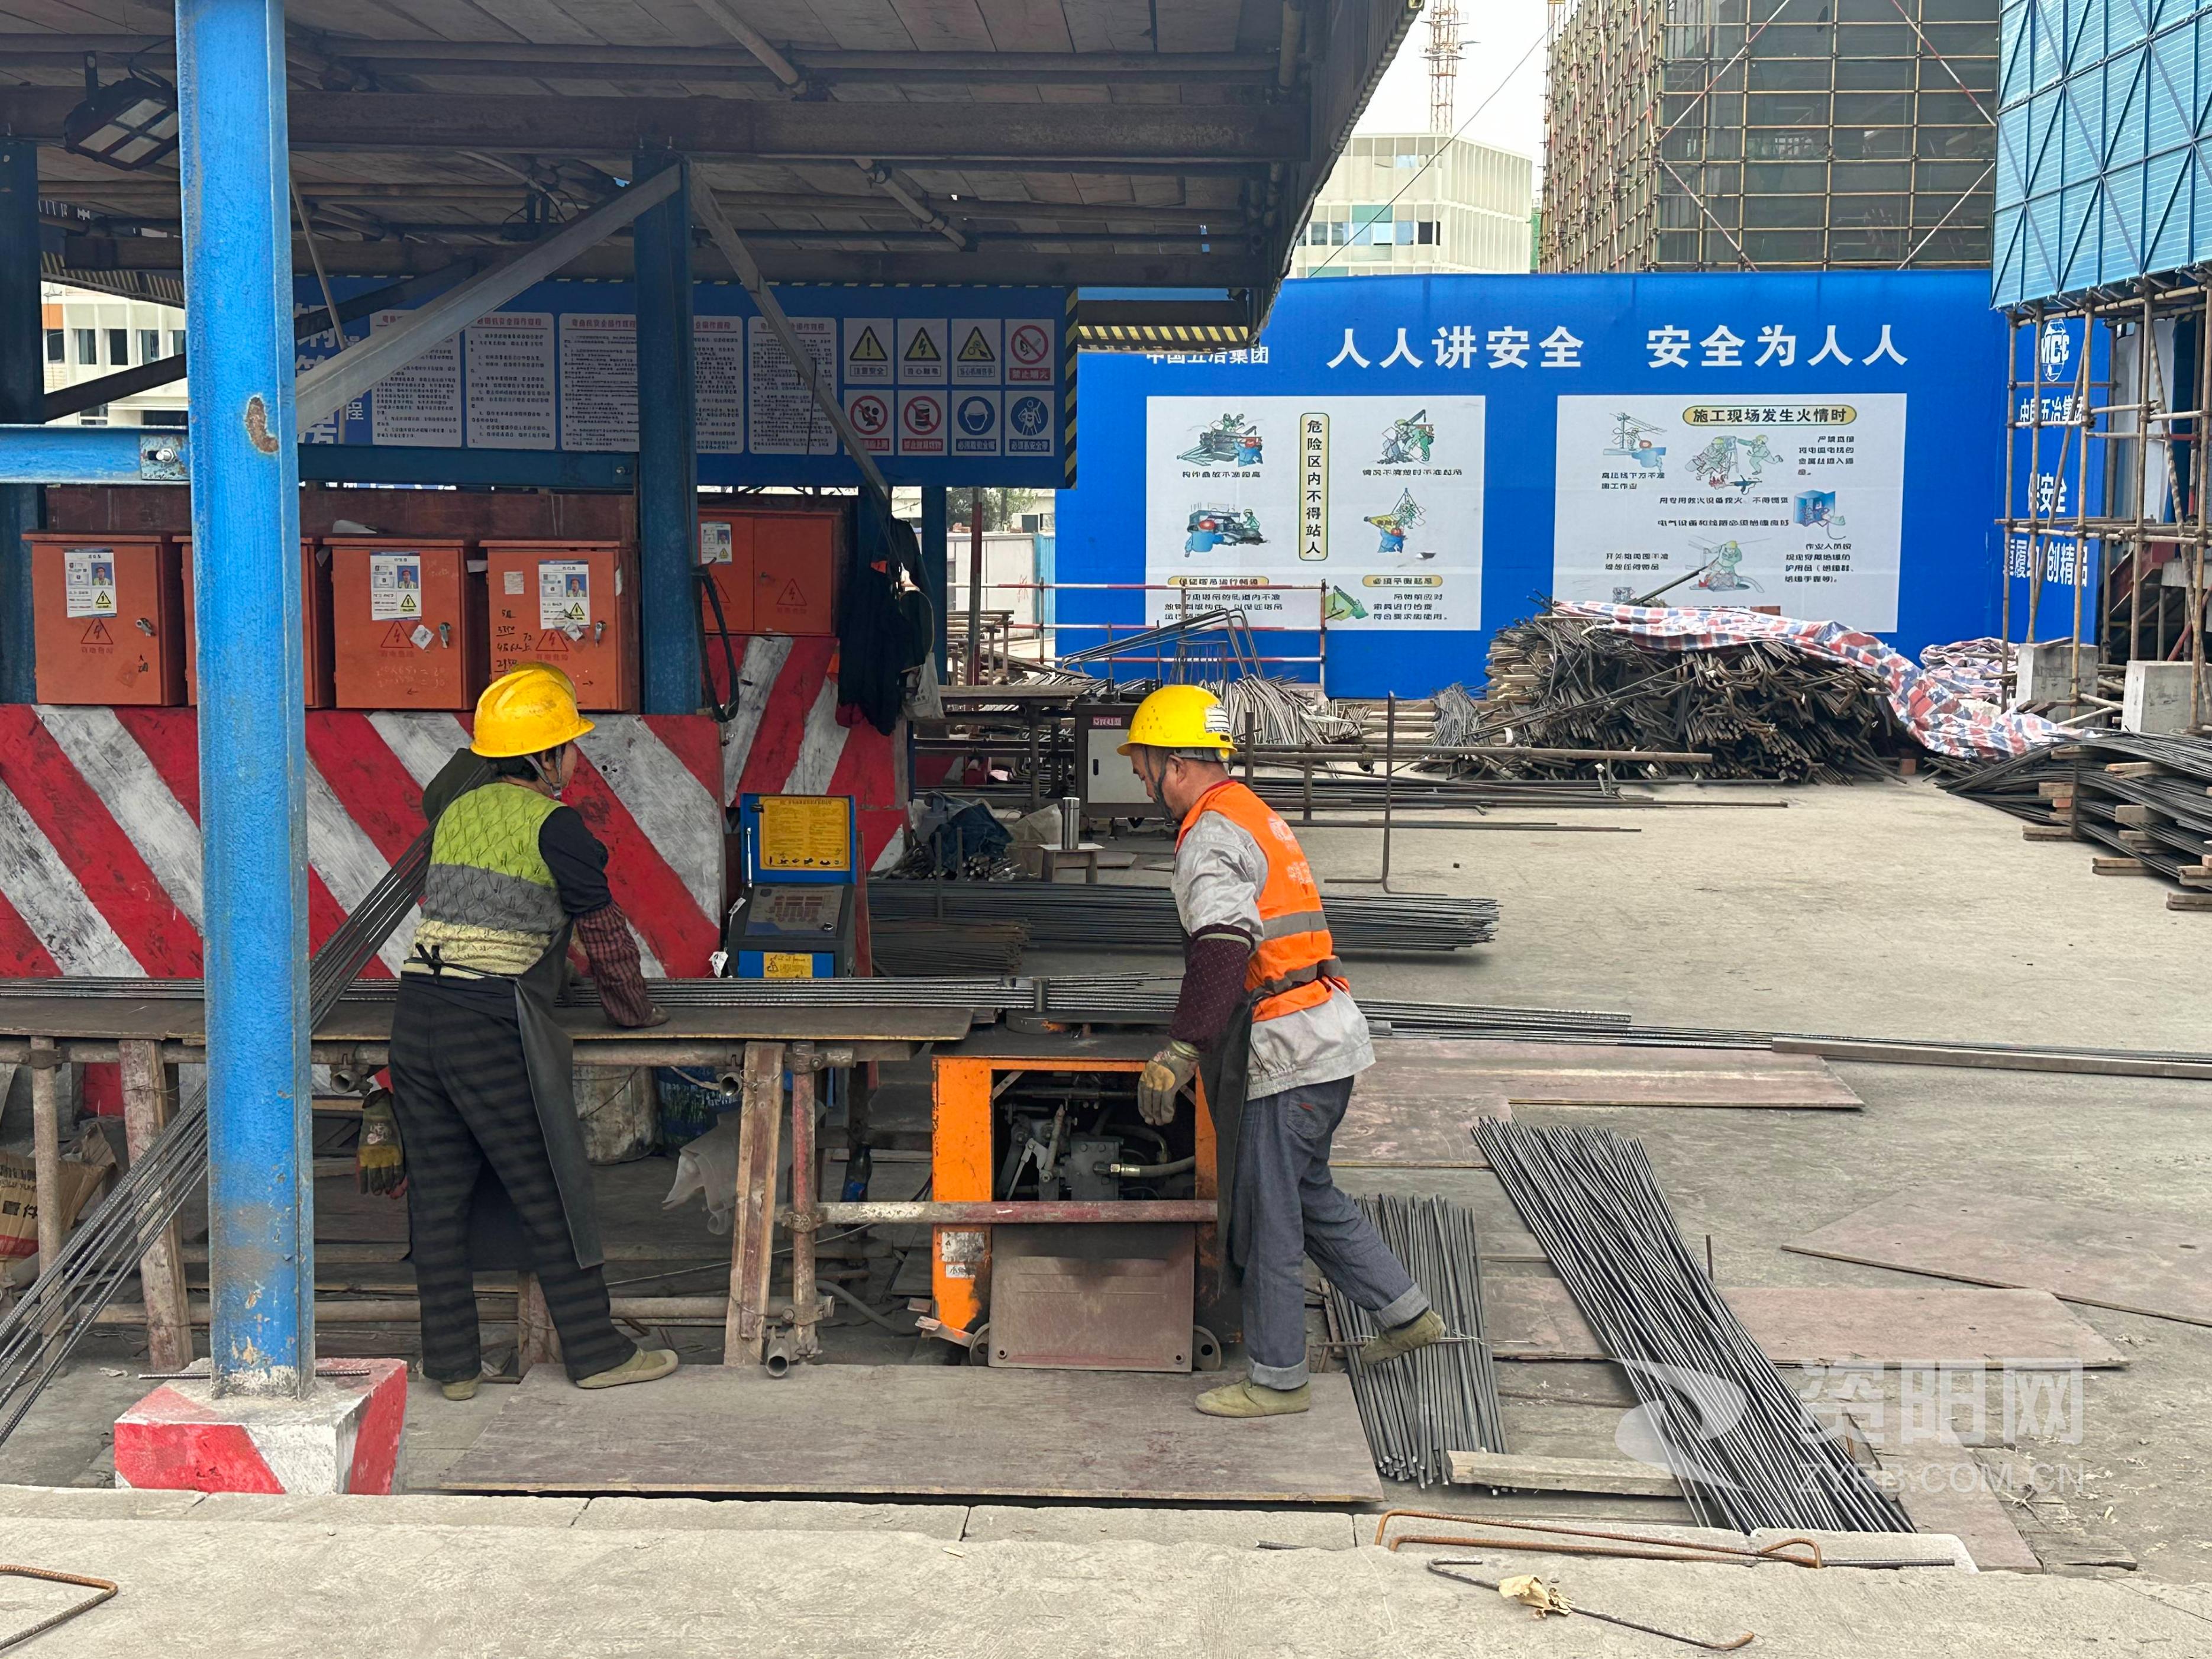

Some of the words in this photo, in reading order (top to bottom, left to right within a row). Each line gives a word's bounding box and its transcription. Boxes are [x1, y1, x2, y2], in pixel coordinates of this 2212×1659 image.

[1326, 325, 1584, 369] 人人讲安全
[1646, 324, 1908, 369] 安全为人人
[1693, 408, 1847, 423] 施工现场发生火情时
[1306, 419, 1323, 555] 危险区内不得站人
